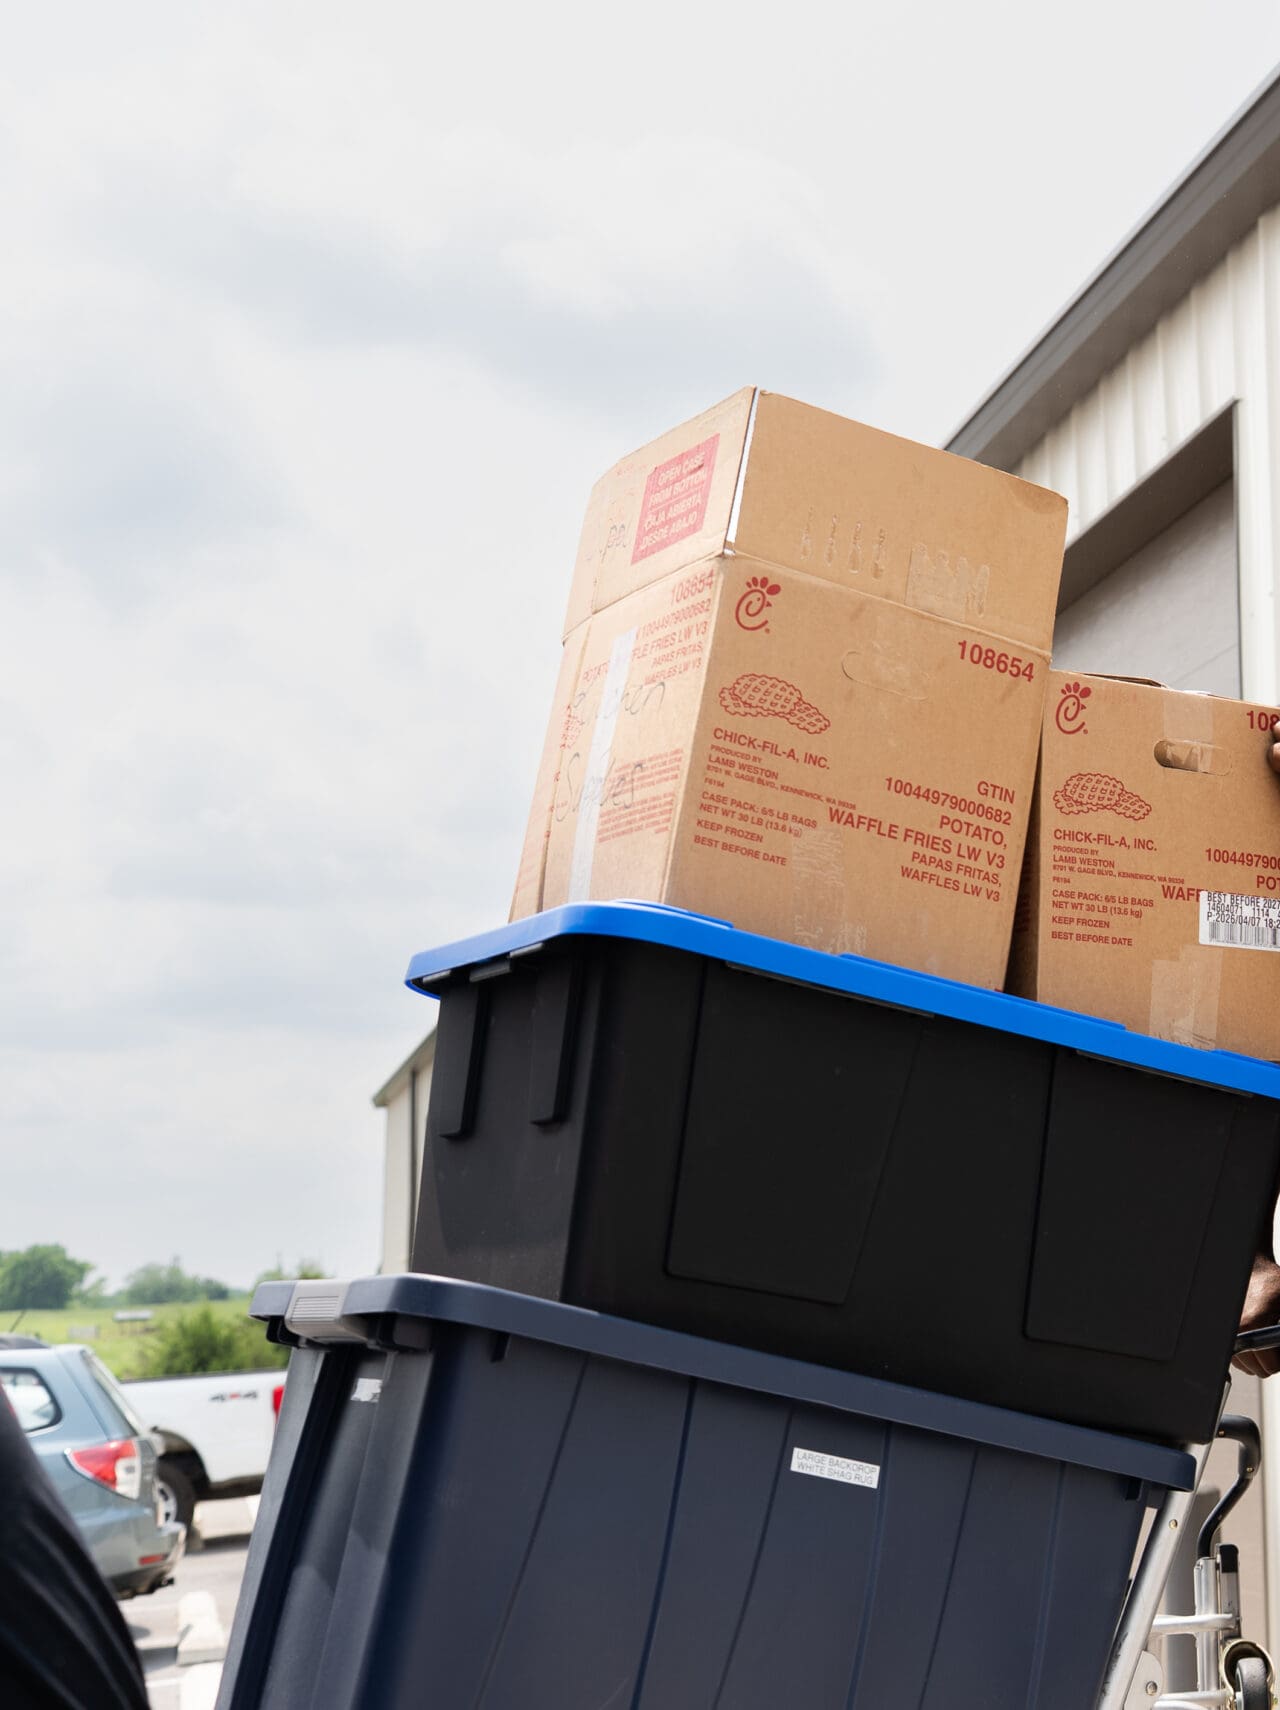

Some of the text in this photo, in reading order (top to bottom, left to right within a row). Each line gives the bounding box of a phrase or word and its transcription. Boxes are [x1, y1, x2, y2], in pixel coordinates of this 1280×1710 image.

[671, 568, 714, 606] 108654
[649, 631, 678, 654] FRIES
[958, 640, 1034, 682] 108654
[1247, 710, 1280, 732] 108
[710, 743, 763, 764] PRODUCED BY
[713, 727, 830, 770] CHICK-FIL-A, INC.
[708, 754, 779, 780] LAMB WESTON
[885, 777, 1012, 826] 10044979000682
[977, 780, 1016, 804] GTIN
[699, 802, 720, 816] NET
[721, 807, 737, 820] WT
[737, 811, 749, 823] 30
[750, 815, 764, 827] LB
[765, 819, 787, 833] (13.6
[702, 791, 819, 829] CASE PACK: 6/5 LB BAGS
[696, 818, 764, 843] KEEP FROZEN
[828, 806, 1006, 869] WAFFLE FRIES LW V3
[939, 815, 1008, 850] POTATO,
[1053, 828, 1158, 851] CHICK-FIL-A, INC.
[693, 834, 788, 866] BEST BEFORE DATE
[1053, 845, 1089, 855] PRODUCED
[1053, 855, 1115, 869] LAMB WESTON
[911, 851, 1002, 888] PAPAS FRITAS,
[901, 865, 1001, 902] WAFFLES LW V3
[1162, 884, 1201, 902] WAFF
[1052, 889, 1154, 908] CASE PACK: 6/5 LB BAGS
[1052, 900, 1143, 919] NET WT 30 LB (13.6 kg)
[1207, 892, 1227, 903] BEST
[1230, 894, 1261, 908] BEFORE
[1207, 902, 1243, 915] 14604071
[1252, 907, 1270, 918] 1114
[1052, 916, 1110, 929] KEEP FROZEN
[1051, 931, 1133, 946] BEST BEFORE DATE
[796, 1451, 877, 1475] LARGE BACKDROP
[797, 1461, 873, 1485] WHITE SHAG RUG
